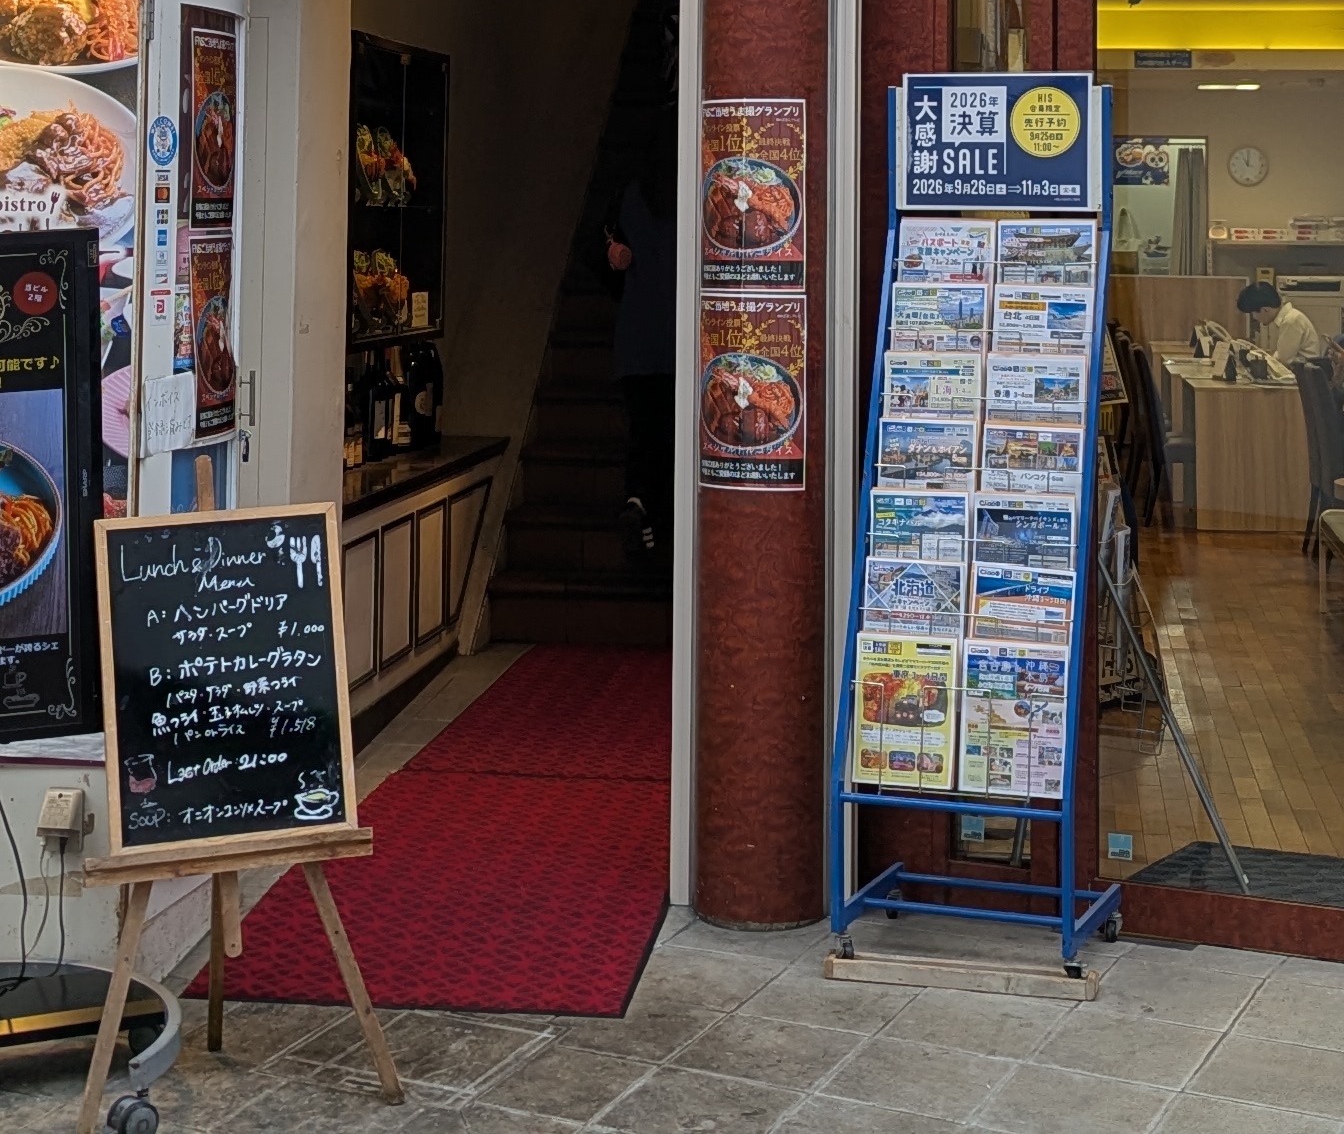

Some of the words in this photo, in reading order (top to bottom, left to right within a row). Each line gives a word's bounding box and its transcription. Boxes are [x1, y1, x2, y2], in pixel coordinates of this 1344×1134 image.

[950, 92, 1000, 108] 2026年
[1037, 93, 1053, 103] HIS
[913, 95, 939, 175] 大感謝
[949, 111, 1000, 137] 決算
[942, 148, 998, 175] SALE
[120, 544, 188, 582] Lunch
